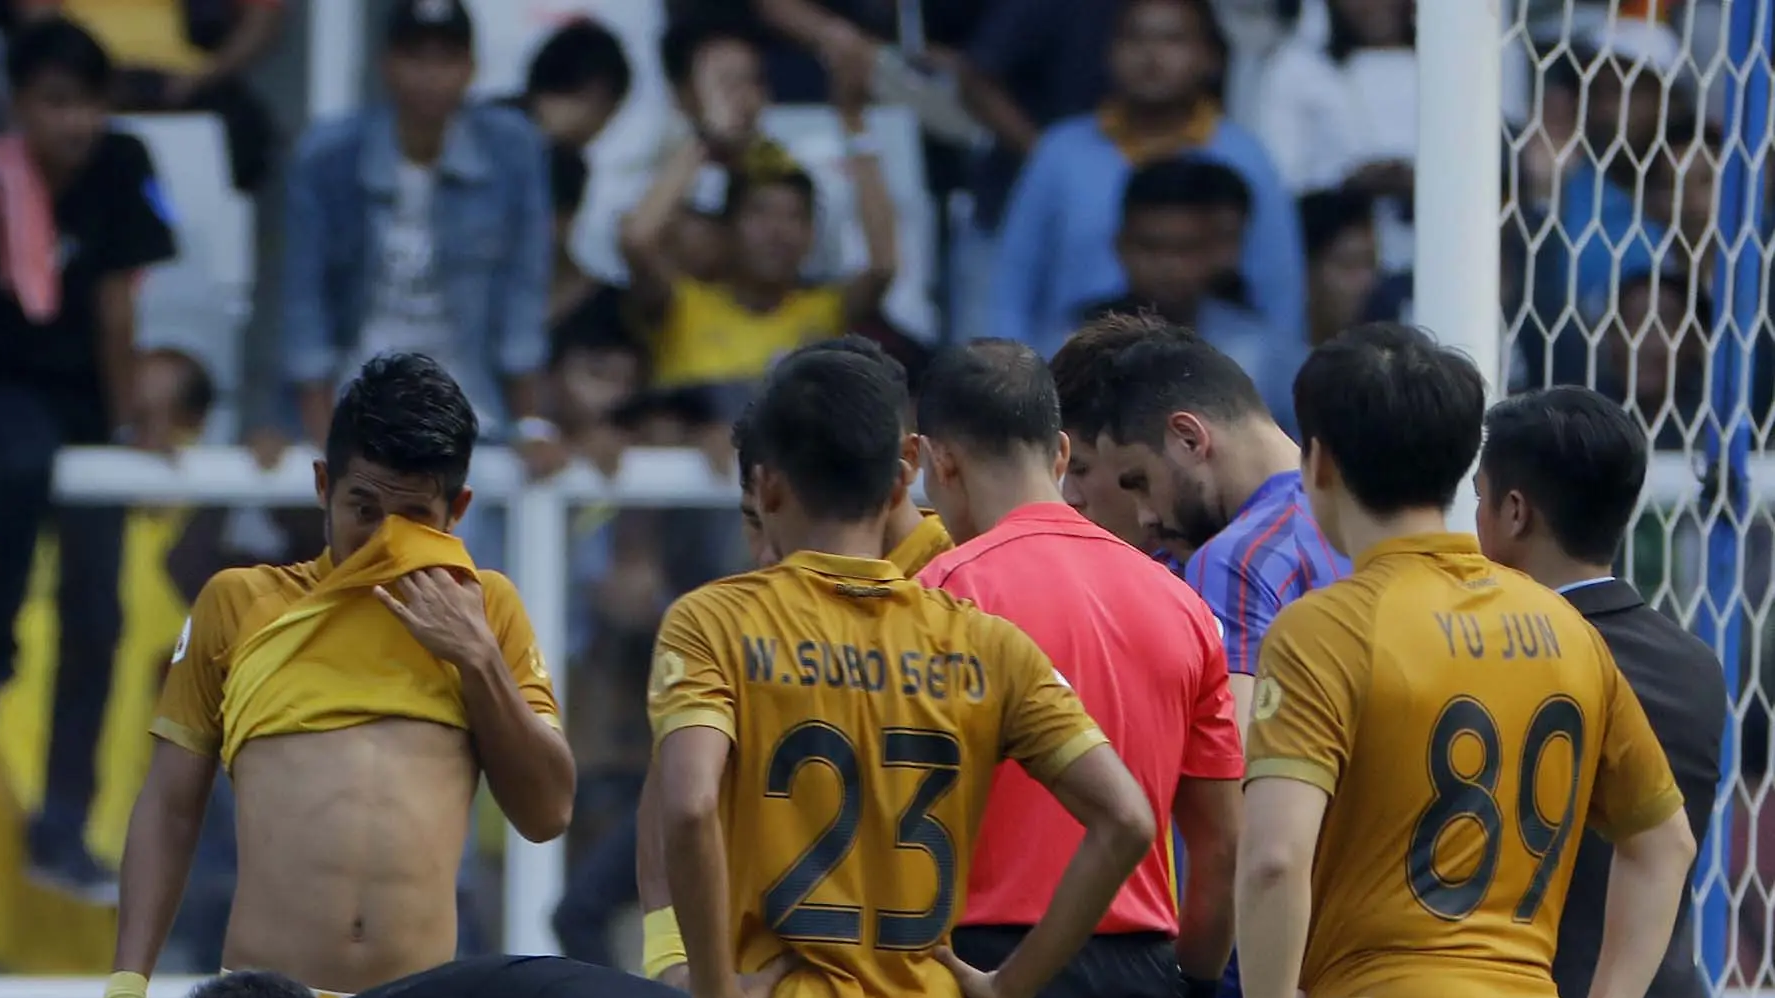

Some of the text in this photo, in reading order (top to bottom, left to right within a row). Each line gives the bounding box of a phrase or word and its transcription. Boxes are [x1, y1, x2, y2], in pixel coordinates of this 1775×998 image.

[900, 651, 987, 704] SETO
[1434, 612, 1562, 660] YU JUN
[762, 719, 962, 951] 23
[1405, 693, 1585, 924] 89
